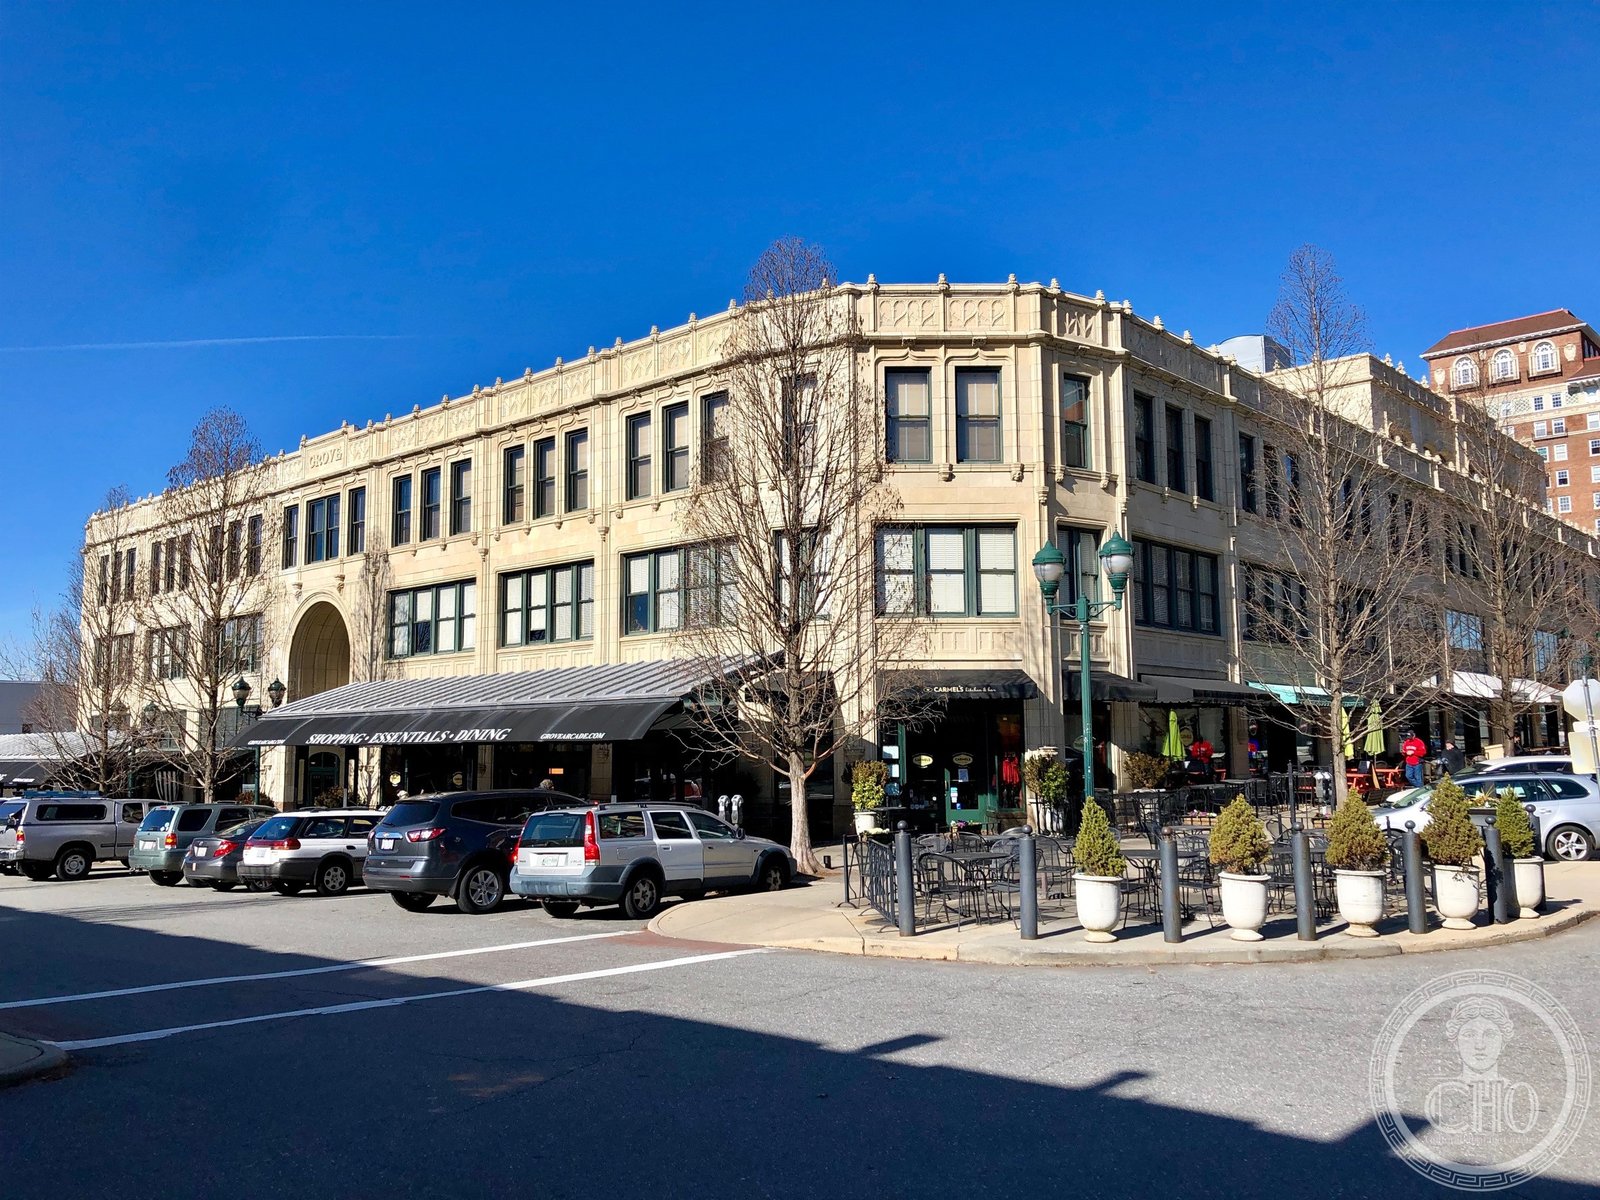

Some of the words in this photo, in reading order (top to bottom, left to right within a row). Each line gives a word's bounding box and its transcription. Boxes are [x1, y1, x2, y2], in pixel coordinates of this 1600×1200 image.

[309, 448, 344, 469] GROVE
[933, 685, 964, 693] CARMEL'S
[306, 732, 366, 745] SHOPPING
[368, 730, 450, 744] ESSENTIALS
[453, 728, 512, 741] DINING
[540, 732, 606, 740] GROVEARCADE.COM
